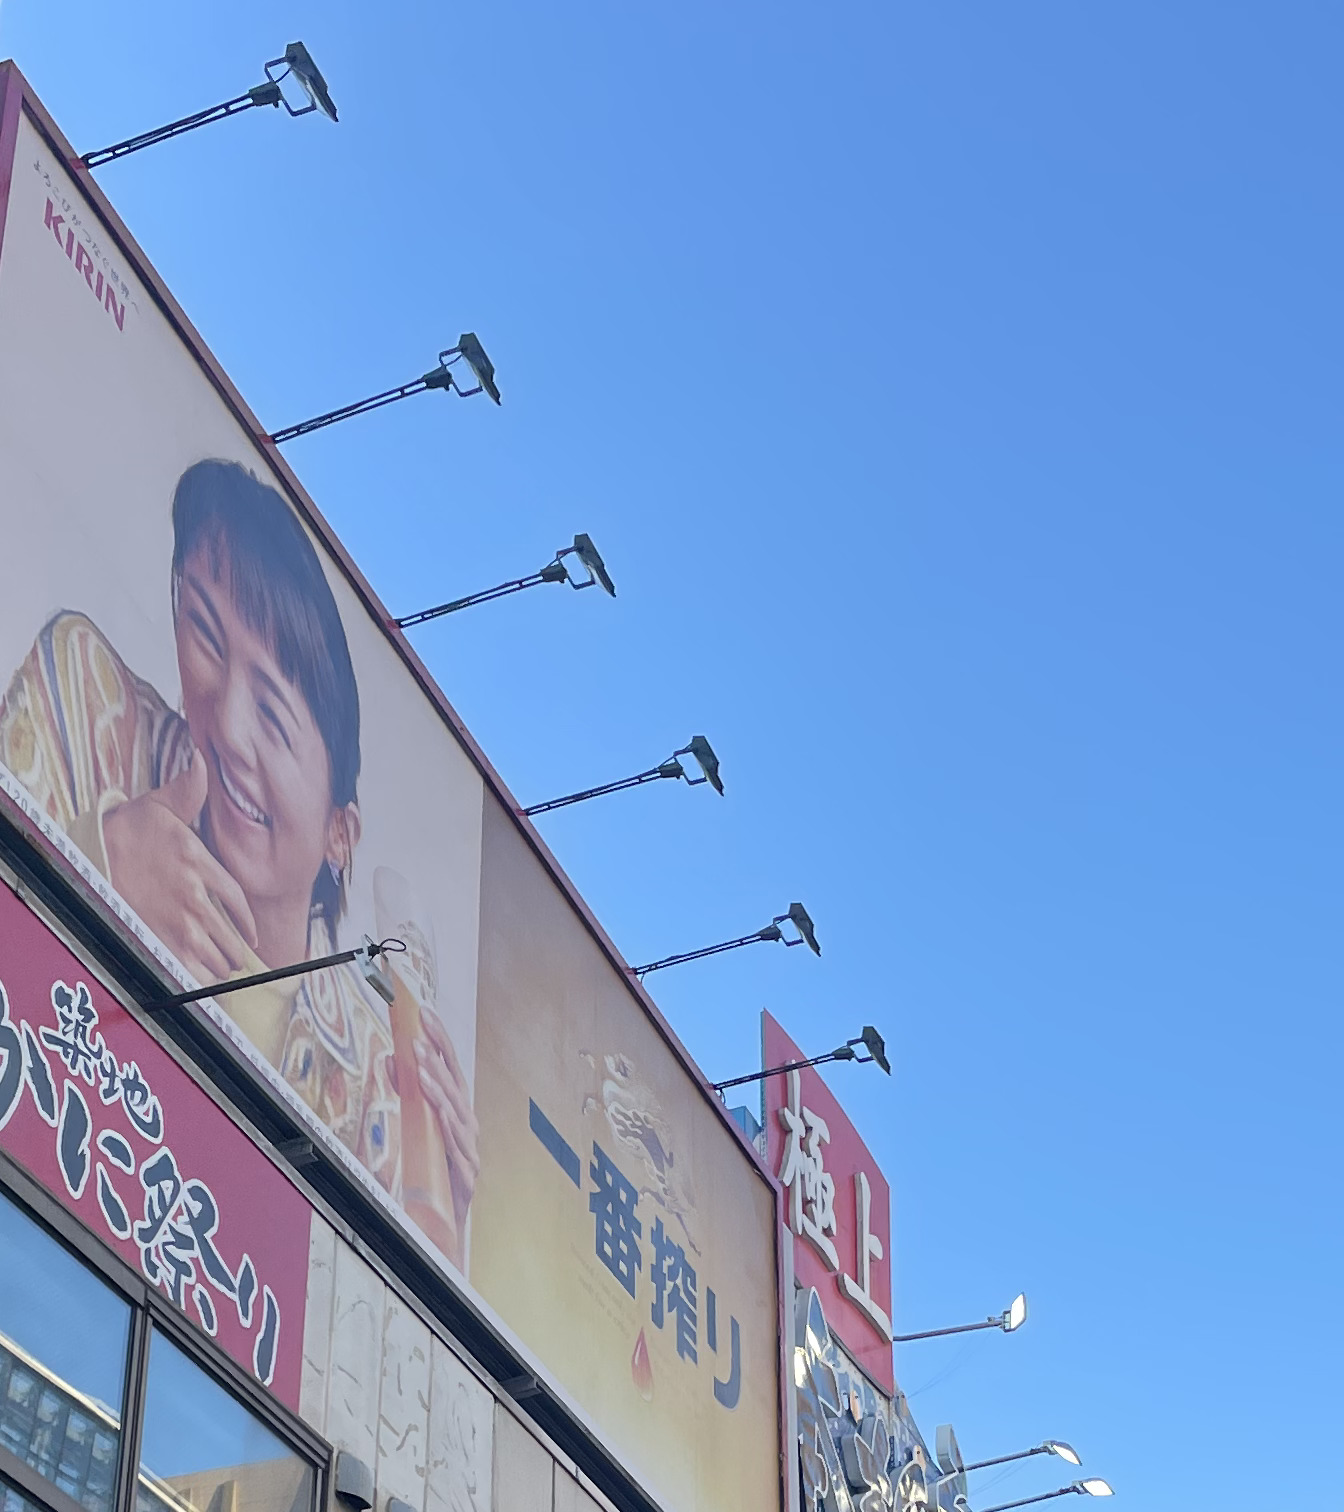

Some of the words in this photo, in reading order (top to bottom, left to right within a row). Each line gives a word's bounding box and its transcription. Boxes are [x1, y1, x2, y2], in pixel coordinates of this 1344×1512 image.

[44, 196, 126, 332] KIRIN
[40, 979, 164, 1144] 築地
[528, 1096, 741, 1410] 一番搾り
[779, 1059, 893, 1343] 極上
